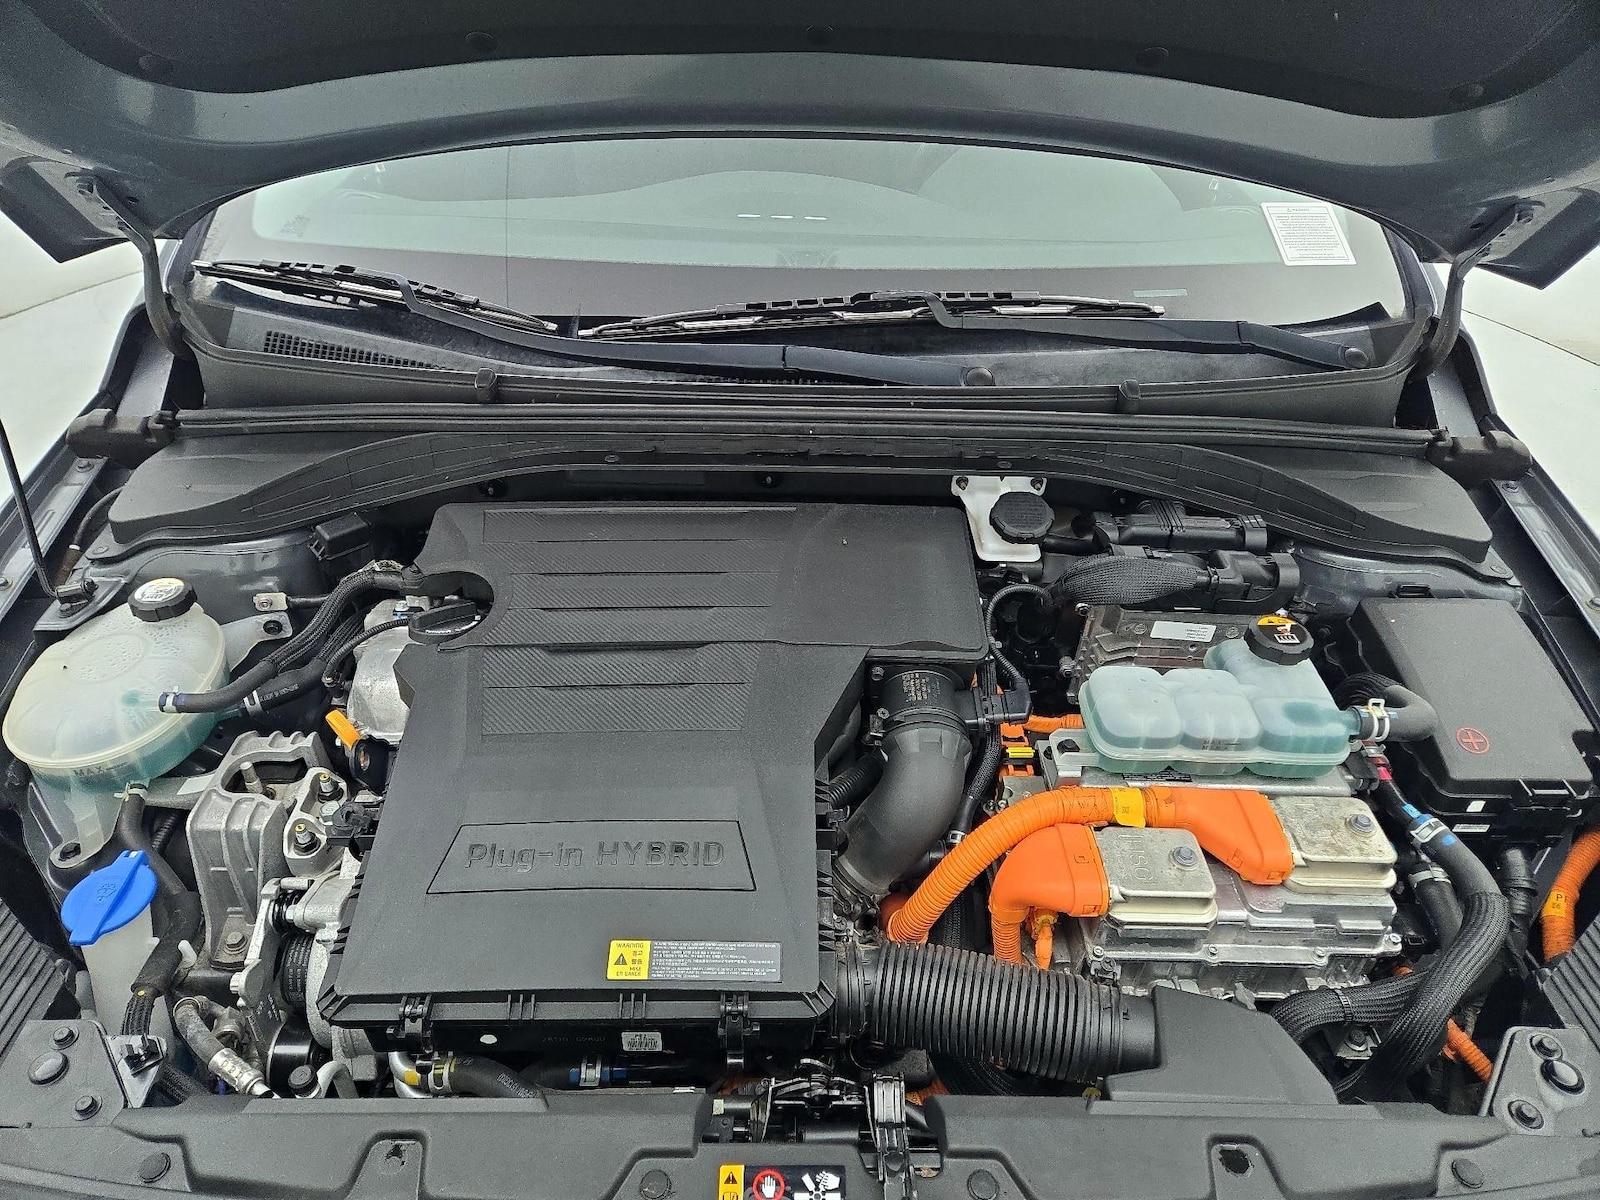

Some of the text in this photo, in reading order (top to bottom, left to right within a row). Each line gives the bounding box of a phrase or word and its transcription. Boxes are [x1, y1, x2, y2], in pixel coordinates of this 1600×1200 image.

[73, 765, 104, 777] MAX
[464, 841, 724, 873] Plug-in HYBRID
